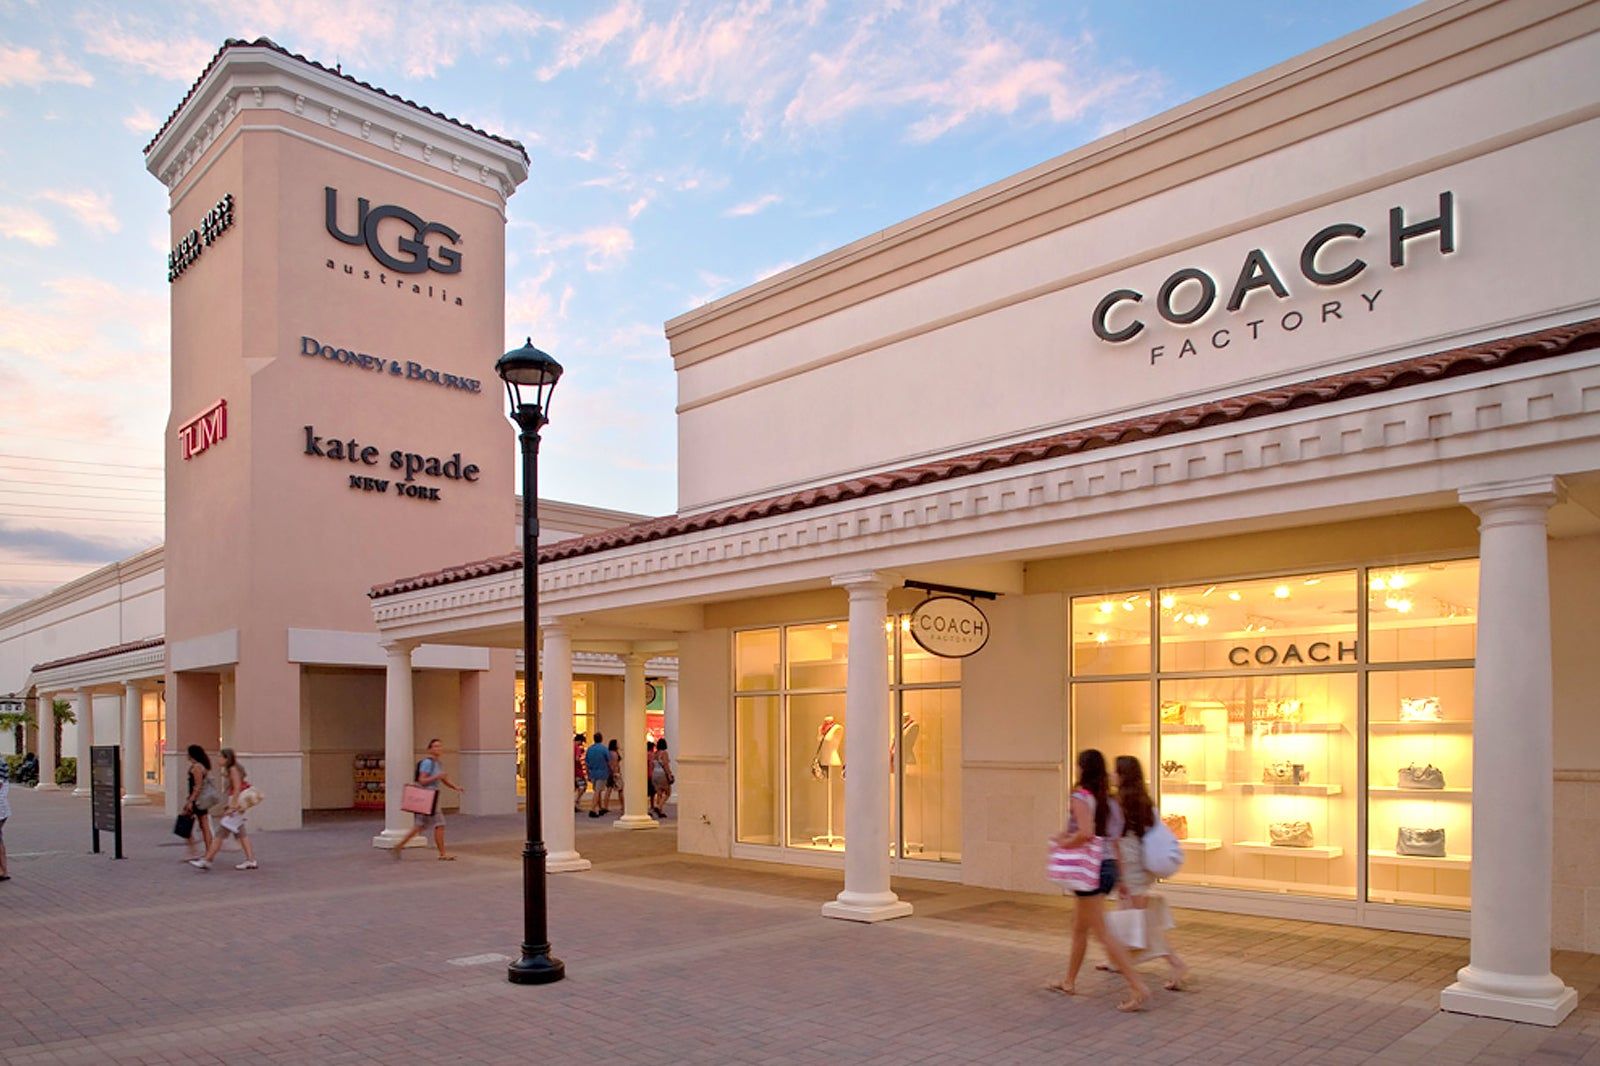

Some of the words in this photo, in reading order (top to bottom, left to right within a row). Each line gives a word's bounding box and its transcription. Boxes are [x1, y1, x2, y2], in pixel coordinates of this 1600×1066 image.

[168, 228, 198, 270] HUGO
[200, 192, 234, 236] BOSS
[325, 186, 462, 275] UGG
[326, 258, 463, 307] australia
[1092, 190, 1454, 344] COACH
[1150, 288, 1383, 366] FACTORY
[301, 335, 386, 373] DOONEY
[389, 360, 403, 376] &
[406, 360, 482, 394] BOURKE
[178, 397, 227, 461] TUMI
[303, 425, 380, 466] kate
[389, 449, 480, 482] spade
[349, 474, 390, 493] NEW
[395, 481, 442, 501] YORK
[920, 614, 984, 636] COACH
[1228, 640, 1358, 667] COACH
